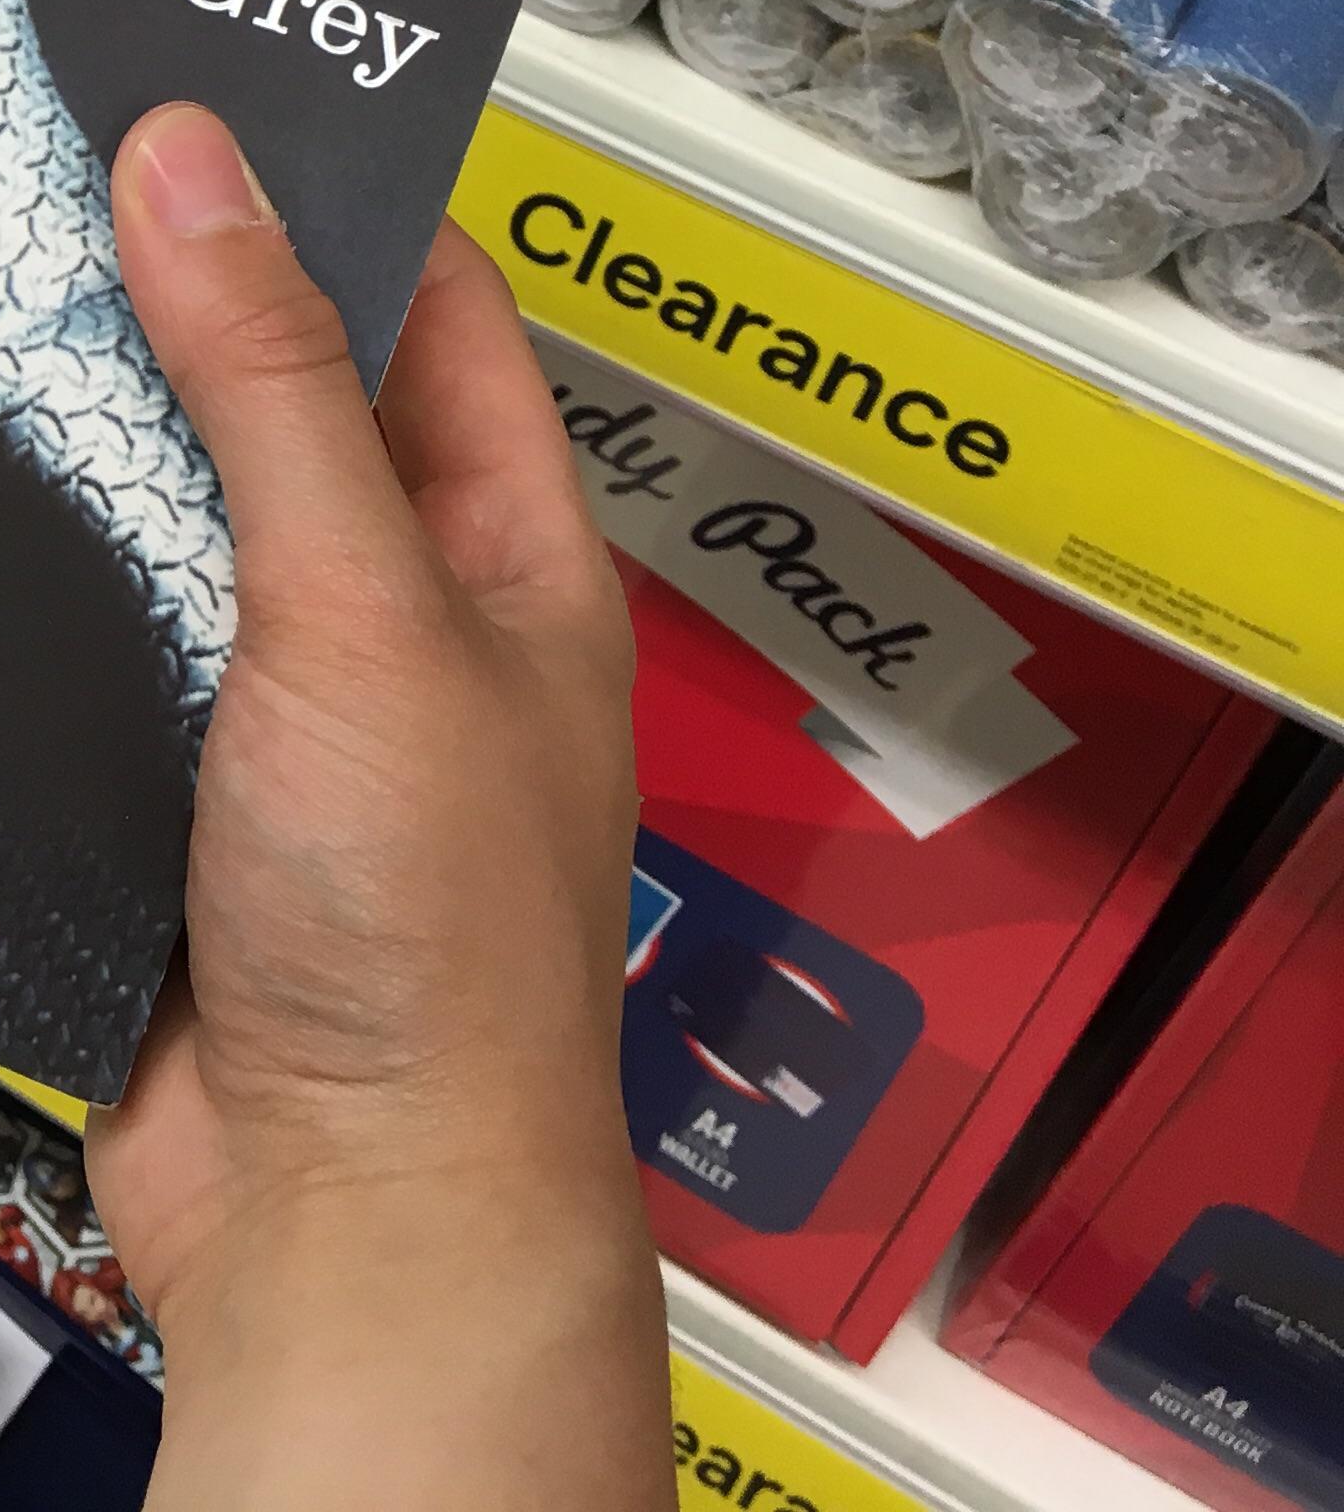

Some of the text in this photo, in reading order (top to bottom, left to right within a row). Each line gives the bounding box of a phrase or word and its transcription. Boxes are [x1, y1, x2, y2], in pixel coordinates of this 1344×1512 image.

[509, 191, 1012, 479] Clearance
[691, 499, 932, 692] Pack
[1201, 1386, 1248, 1420] A4
